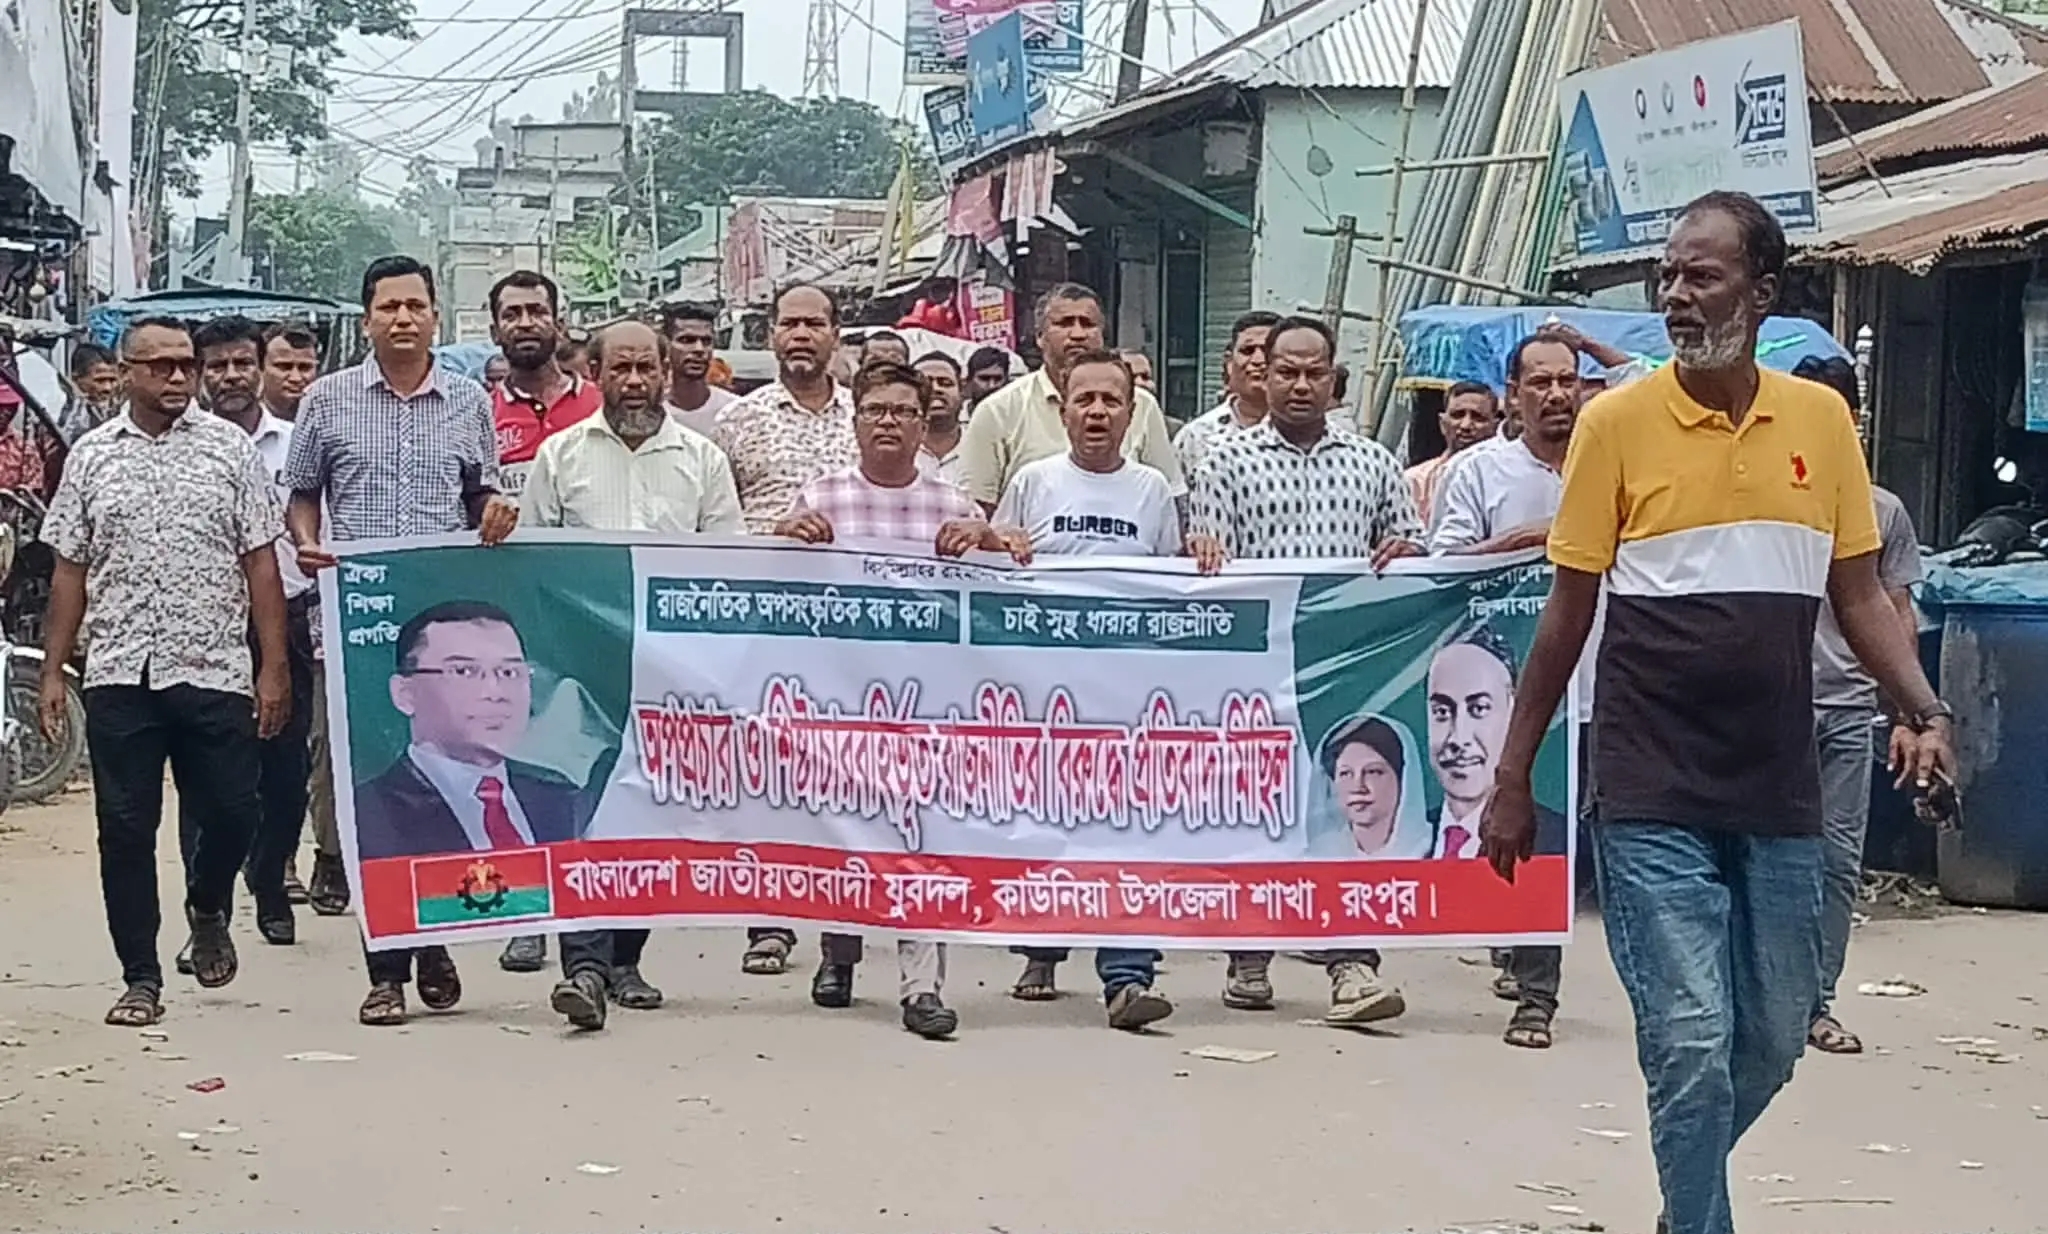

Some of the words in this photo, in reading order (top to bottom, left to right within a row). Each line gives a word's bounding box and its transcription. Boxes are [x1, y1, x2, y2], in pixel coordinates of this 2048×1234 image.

[1465, 563, 1545, 592] বাংলাদে
[345, 592, 395, 615] শিক্ষা
[656, 581, 751, 622] রাজনৈতিক
[897, 599, 942, 632] করো
[1002, 599, 1042, 635] চাই
[1086, 608, 1141, 637] ধারার
[1146, 602, 1235, 637] রাজনীতি
[348, 620, 402, 646] প্রগতি
[1221, 688, 1298, 840] মিছিল
[560, 854, 681, 902] বাংলাদেশ
[687, 848, 877, 909] জাতীয়তাবাদী
[990, 867, 1109, 920] কাউনিয়া
[1116, 869, 1242, 921] উপজেলা
